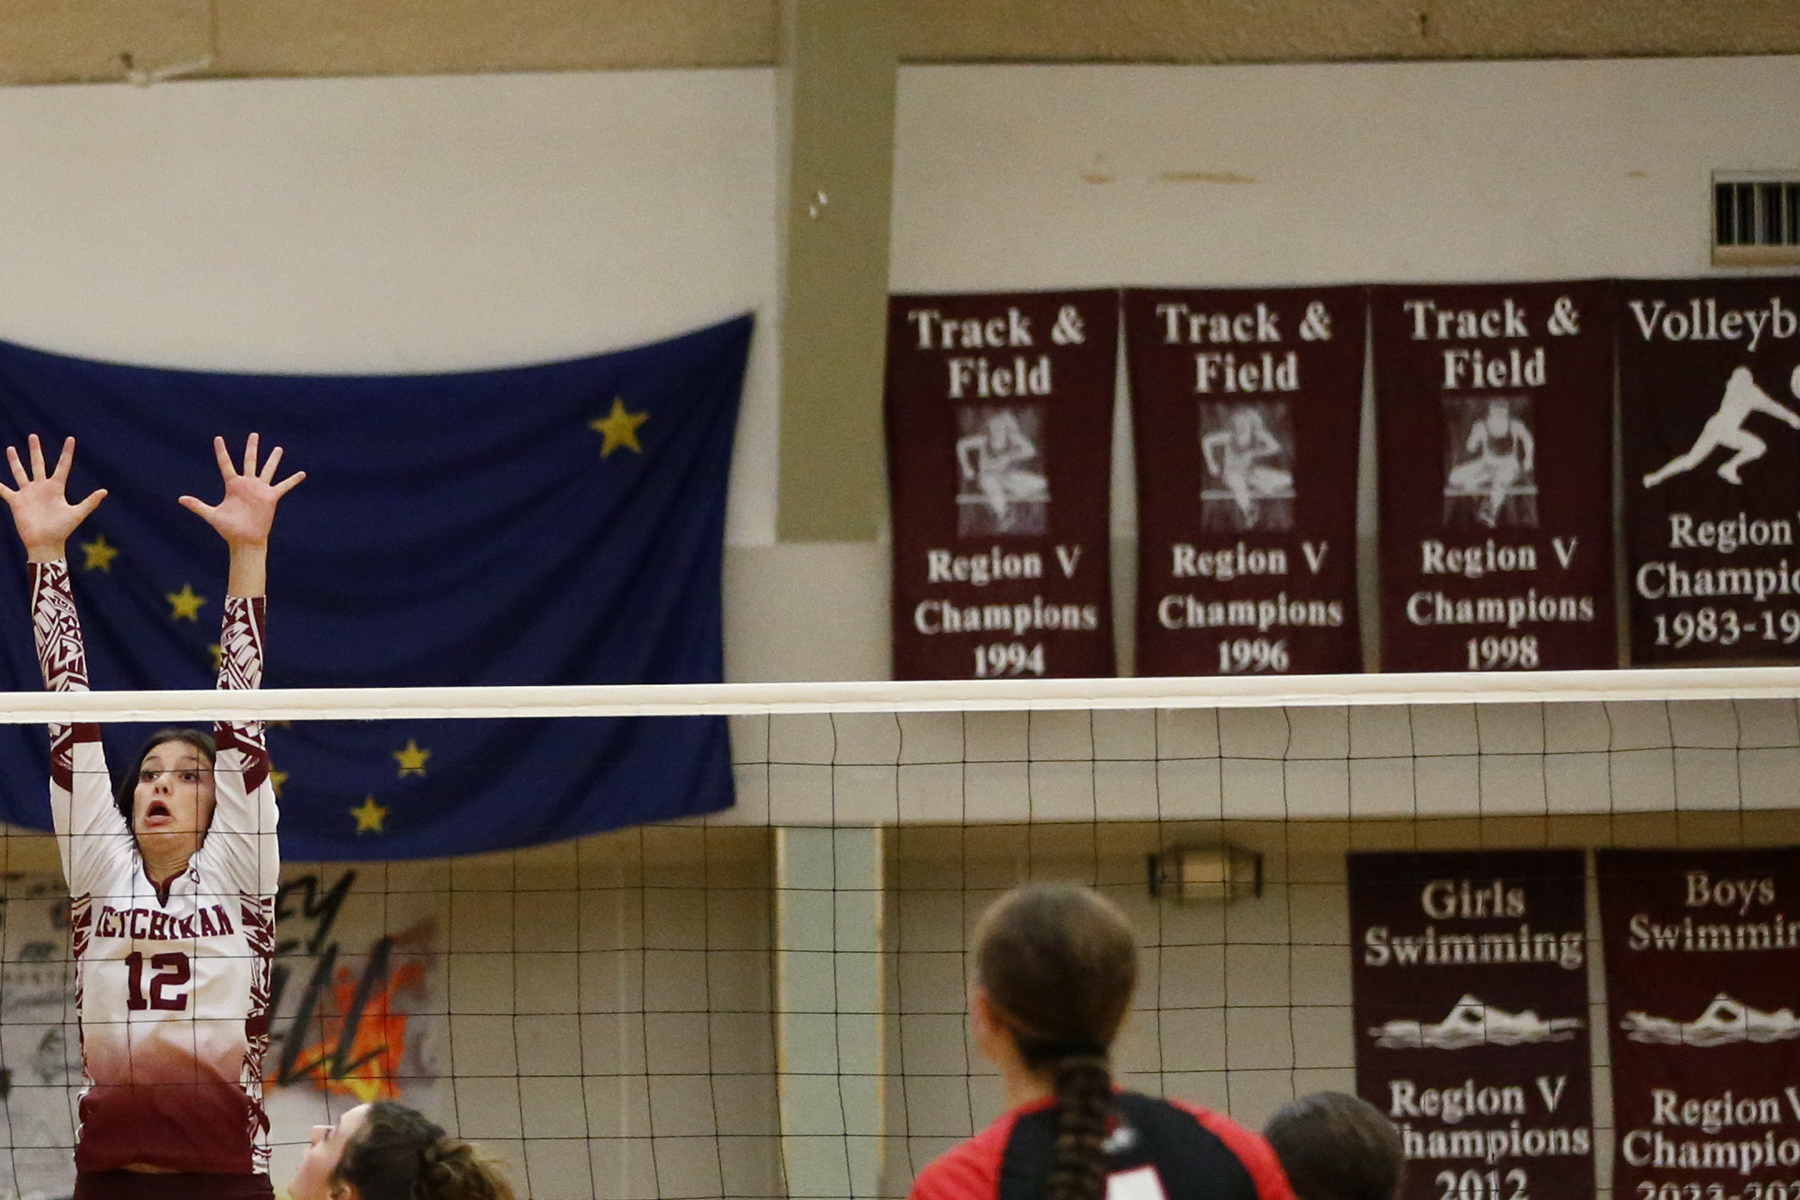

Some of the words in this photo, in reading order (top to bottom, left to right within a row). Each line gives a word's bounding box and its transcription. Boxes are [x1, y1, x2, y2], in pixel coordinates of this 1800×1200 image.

[909, 308, 1033, 350] Track
[1051, 304, 1086, 346] &
[1157, 303, 1281, 345] Track
[1300, 301, 1333, 342] &
[1404, 299, 1529, 340] Track
[1547, 296, 1581, 336] &
[1628, 296, 1800, 352] Volleyb
[948, 356, 1052, 399] Field
[1196, 351, 1299, 394] Field
[1442, 348, 1546, 390] Field
[1669, 511, 1793, 554] Region
[928, 546, 1042, 586] Region
[1056, 545, 1082, 579] V
[1172, 542, 1288, 580] Region
[1303, 541, 1328, 573] V
[1422, 538, 1537, 578] Region
[1552, 537, 1579, 569] V
[914, 597, 1098, 635] Champions
[1158, 593, 1342, 630] Champions
[1407, 589, 1594, 628] Champions
[974, 643, 1046, 678] 1994
[1218, 639, 1289, 674] 1996
[1466, 636, 1540, 671] 1998
[1422, 879, 1526, 919] Girls
[1686, 870, 1775, 916] Boys
[95, 905, 234, 940] ETCHIKAN
[1364, 924, 1583, 969] Swimming
[125, 951, 191, 1011] 12
[1389, 1079, 1526, 1124] Region
[1535, 1076, 1566, 1113] V
[1652, 1088, 1782, 1134] Region
[1396, 1119, 1591, 1165] hampions
